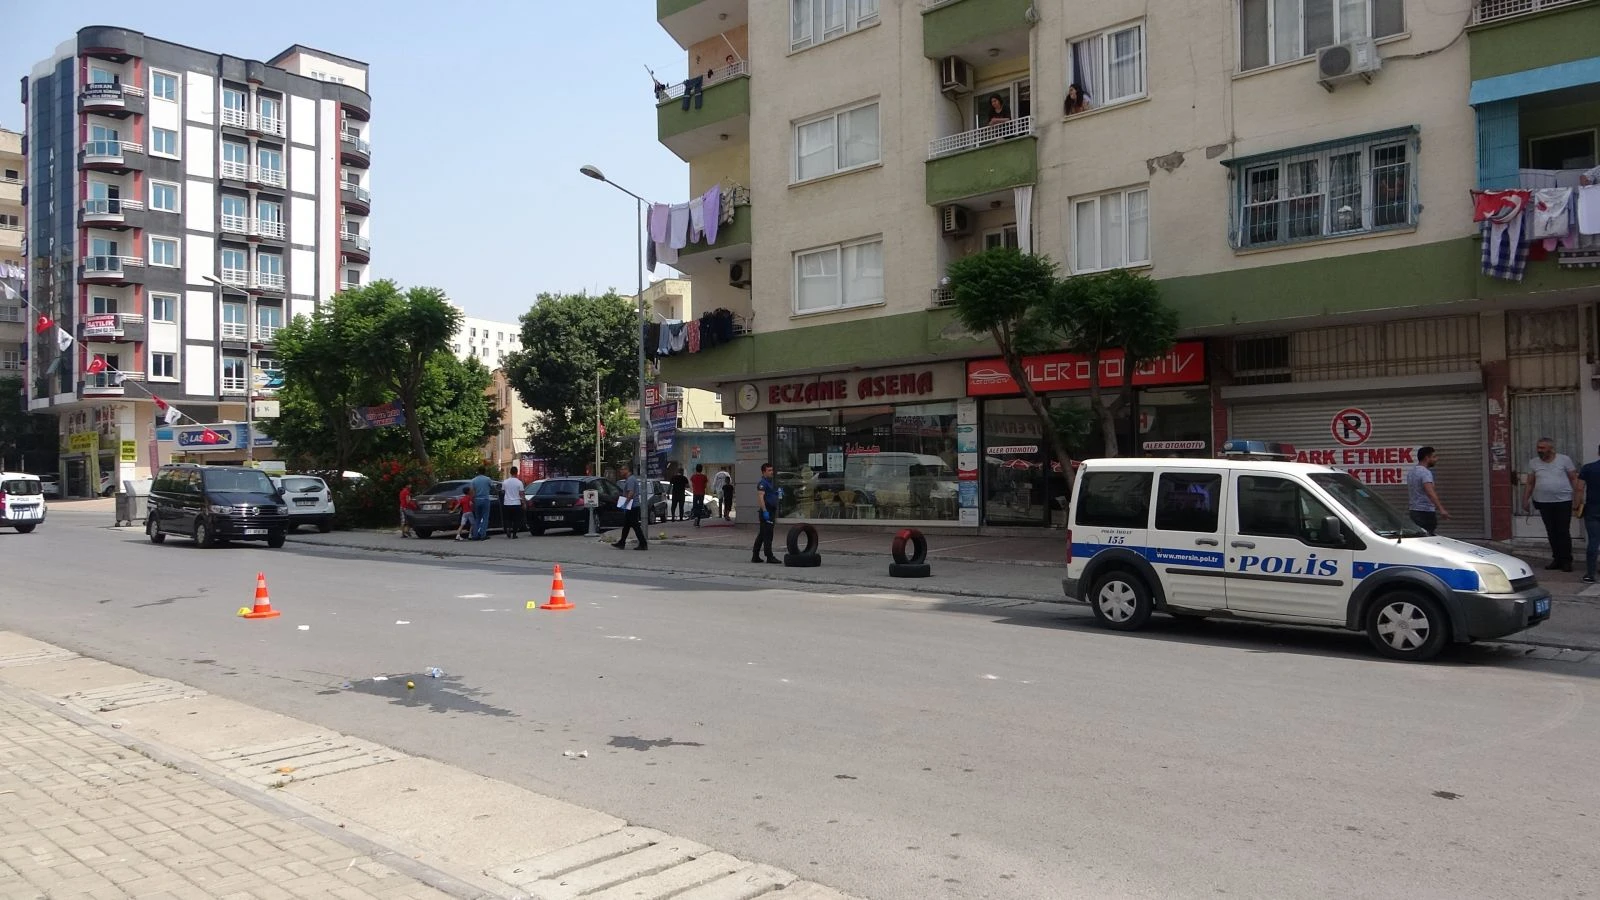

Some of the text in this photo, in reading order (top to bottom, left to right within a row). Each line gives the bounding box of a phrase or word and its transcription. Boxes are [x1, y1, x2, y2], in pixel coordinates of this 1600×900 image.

[87, 320, 115, 328] SATILIK
[768, 379, 848, 404] ECZANE
[1294, 448, 1414, 464] ARK ETMEK
[1108, 536, 1125, 544] 155
[1156, 552, 1218, 563] www.mersin.pol.tr
[1238, 554, 1338, 577] POLİS
